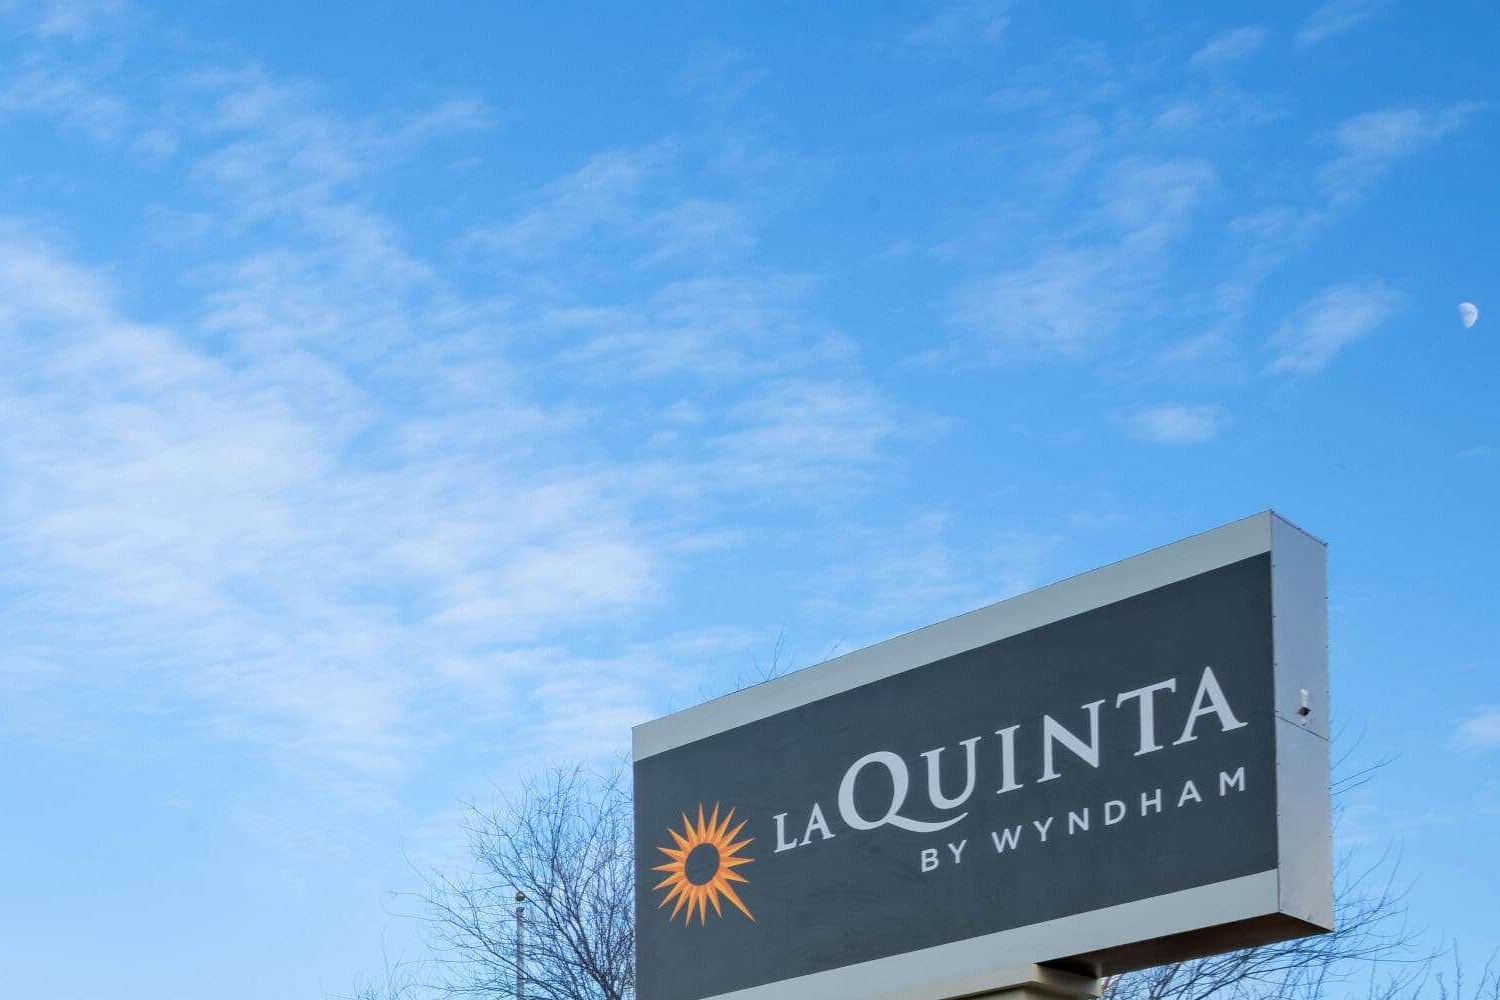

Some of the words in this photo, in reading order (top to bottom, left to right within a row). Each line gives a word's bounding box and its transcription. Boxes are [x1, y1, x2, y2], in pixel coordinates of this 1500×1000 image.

[773, 803, 835, 853] LA
[837, 666, 1248, 833] QUINTA
[920, 838, 967, 873] BY
[991, 767, 1246, 854] WYNDHAM
